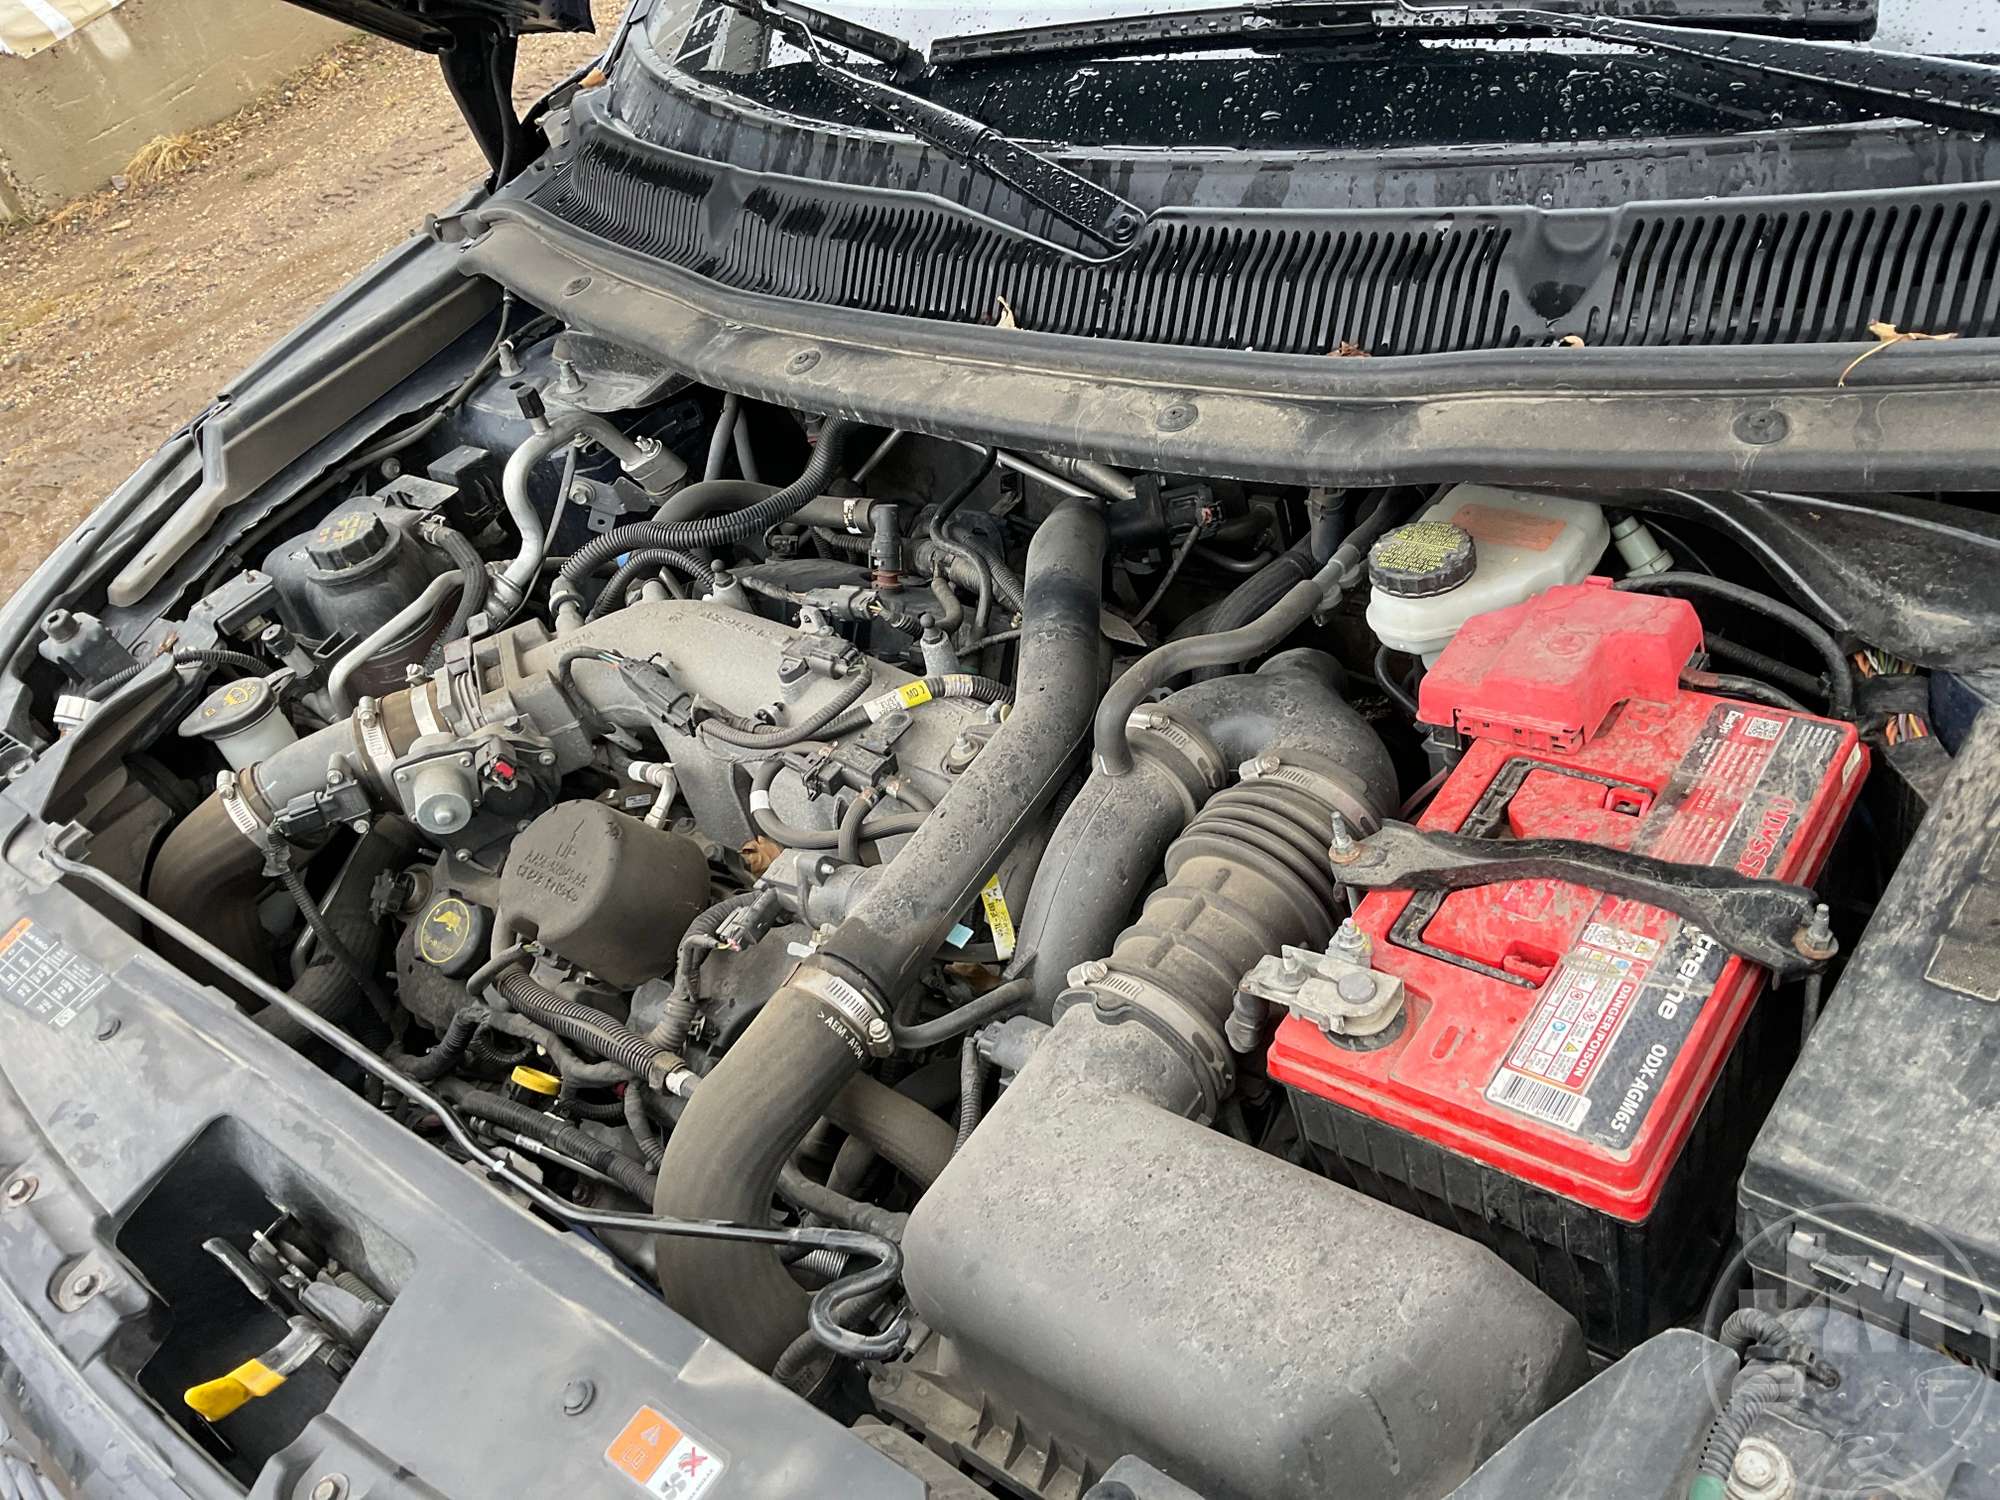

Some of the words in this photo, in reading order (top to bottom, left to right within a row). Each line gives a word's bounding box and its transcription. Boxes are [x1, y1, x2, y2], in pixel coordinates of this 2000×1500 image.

[1734, 797, 1796, 879] ODYSSE
[1655, 934, 1715, 1018] treme
[1572, 982, 1632, 1079] DANGER/POISON
[1608, 1044, 1667, 1132] ODX-AGM65
